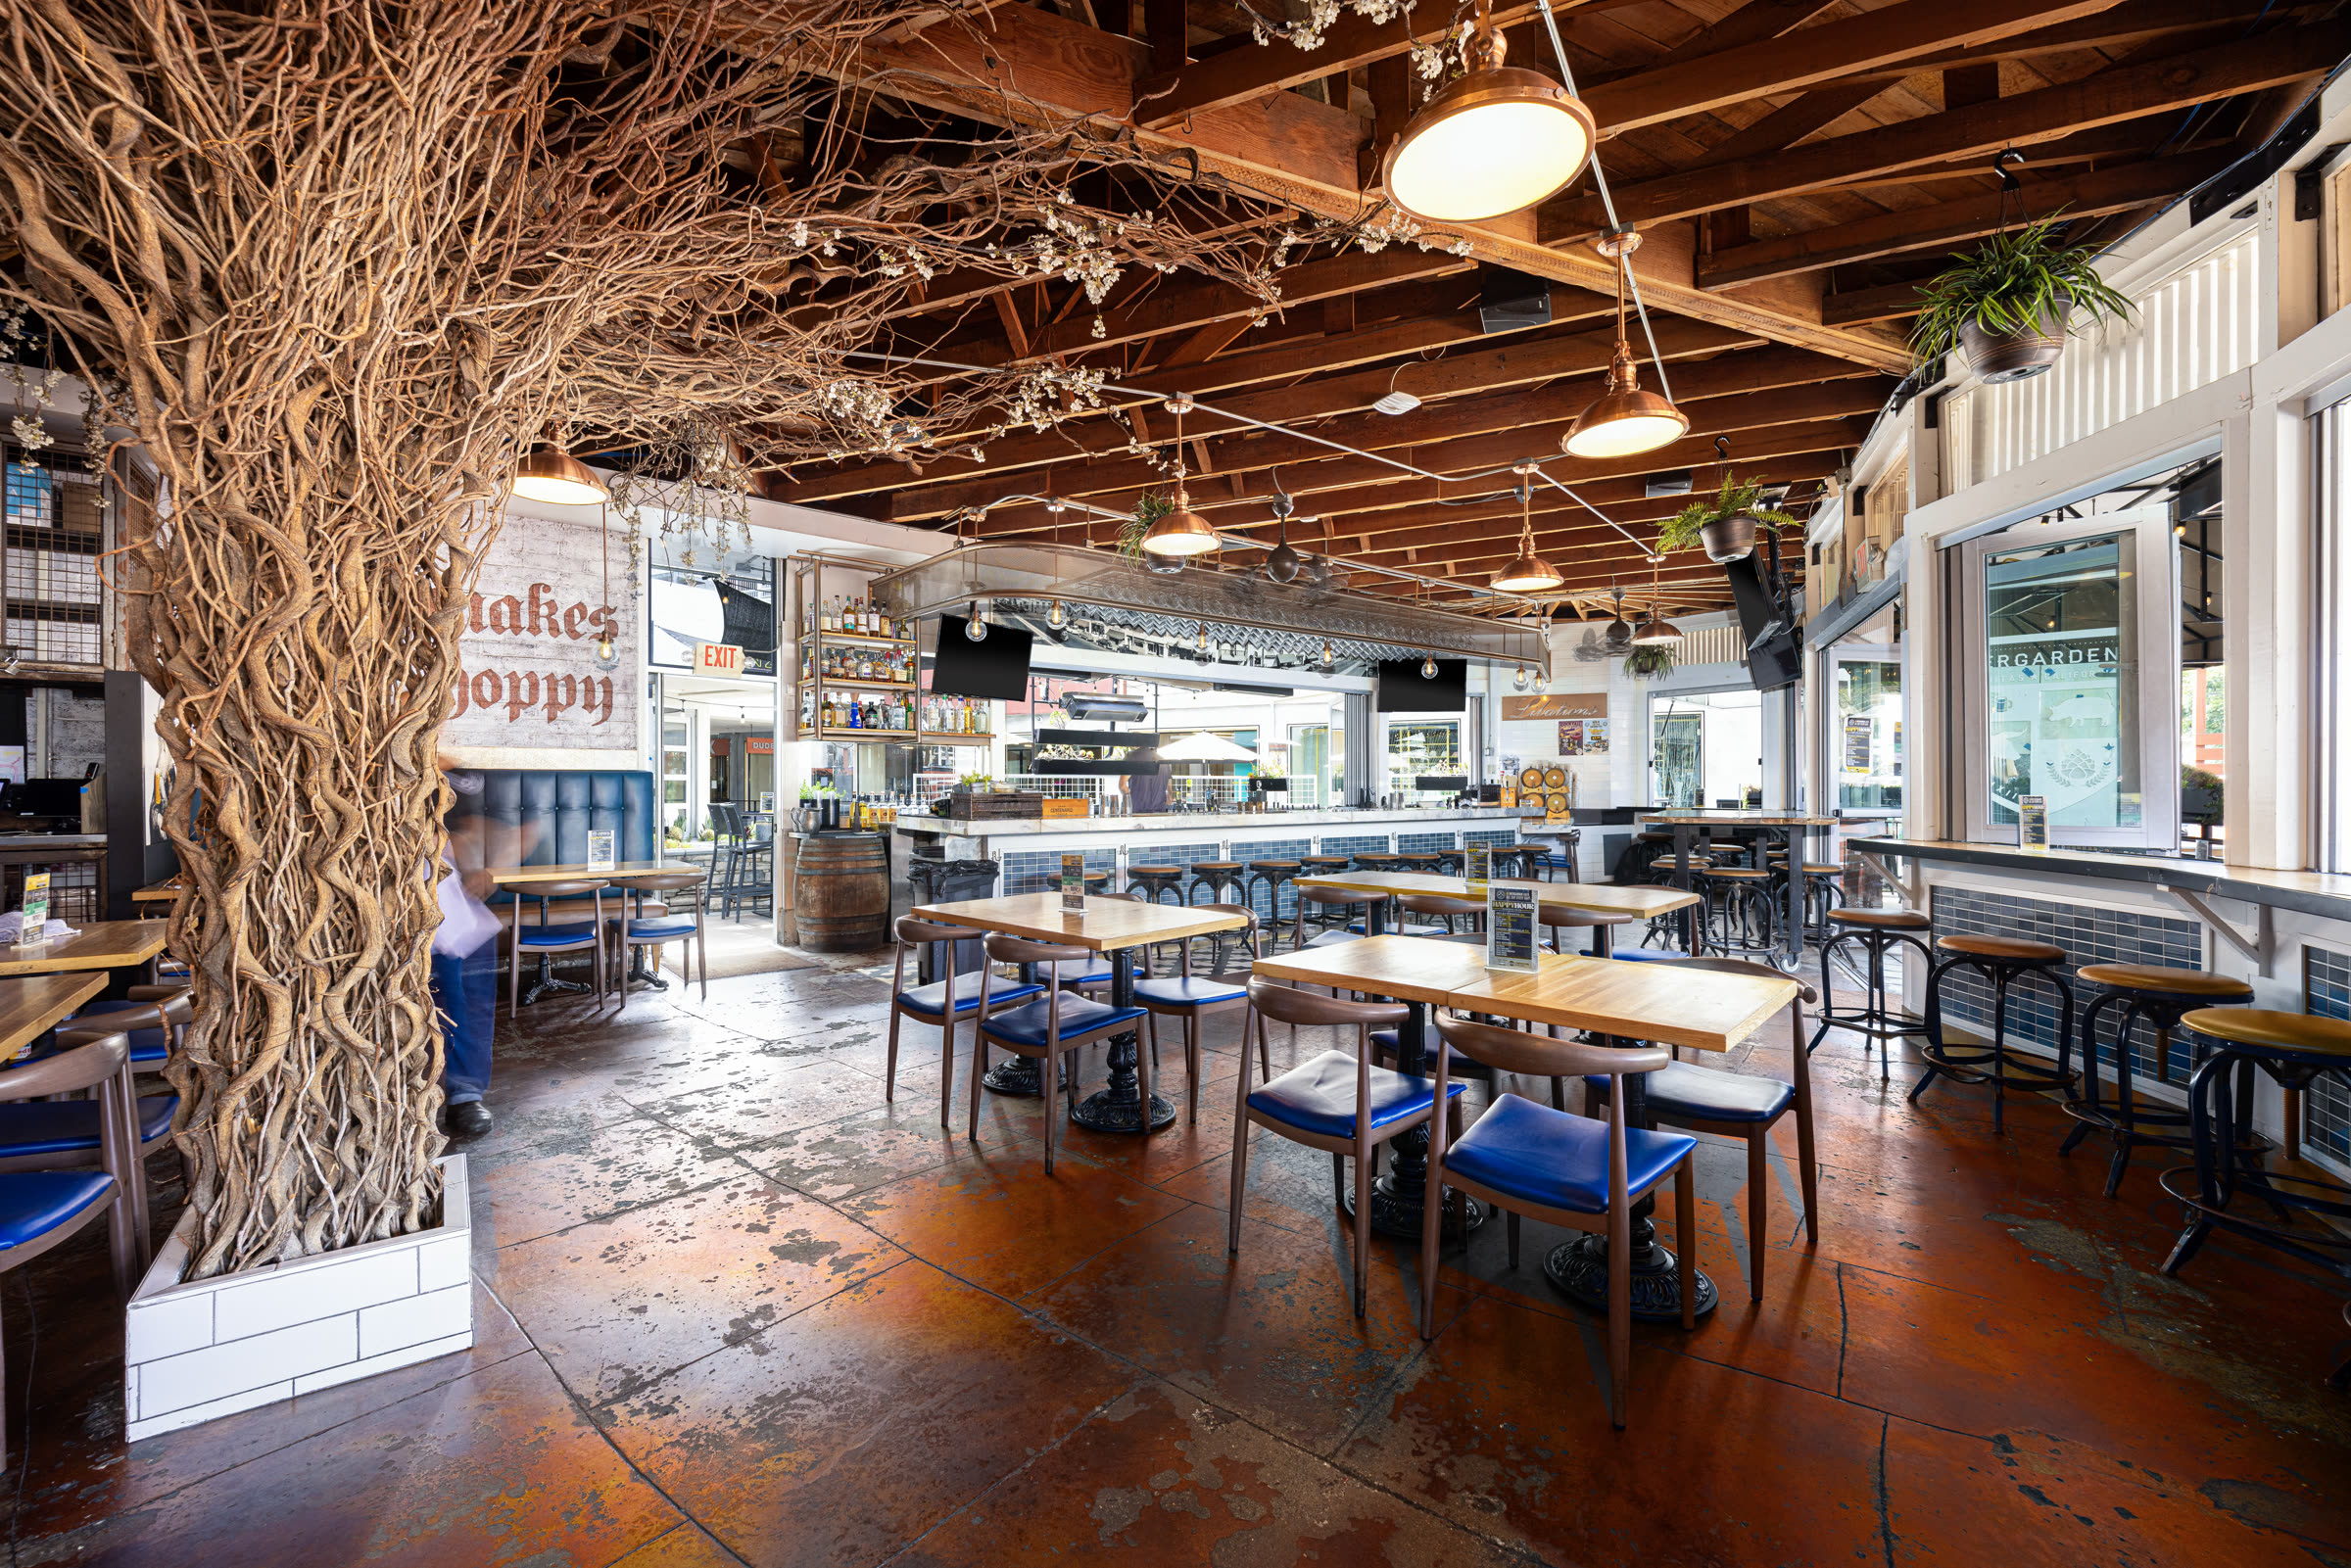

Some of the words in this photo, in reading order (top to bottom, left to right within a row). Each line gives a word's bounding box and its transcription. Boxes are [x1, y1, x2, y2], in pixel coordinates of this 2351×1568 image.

[1856, 544, 1867, 578] EXIT
[704, 644, 738, 669] EXIT
[1990, 646, 2119, 667] RGARDEN
[1511, 697, 1600, 719] Libations
